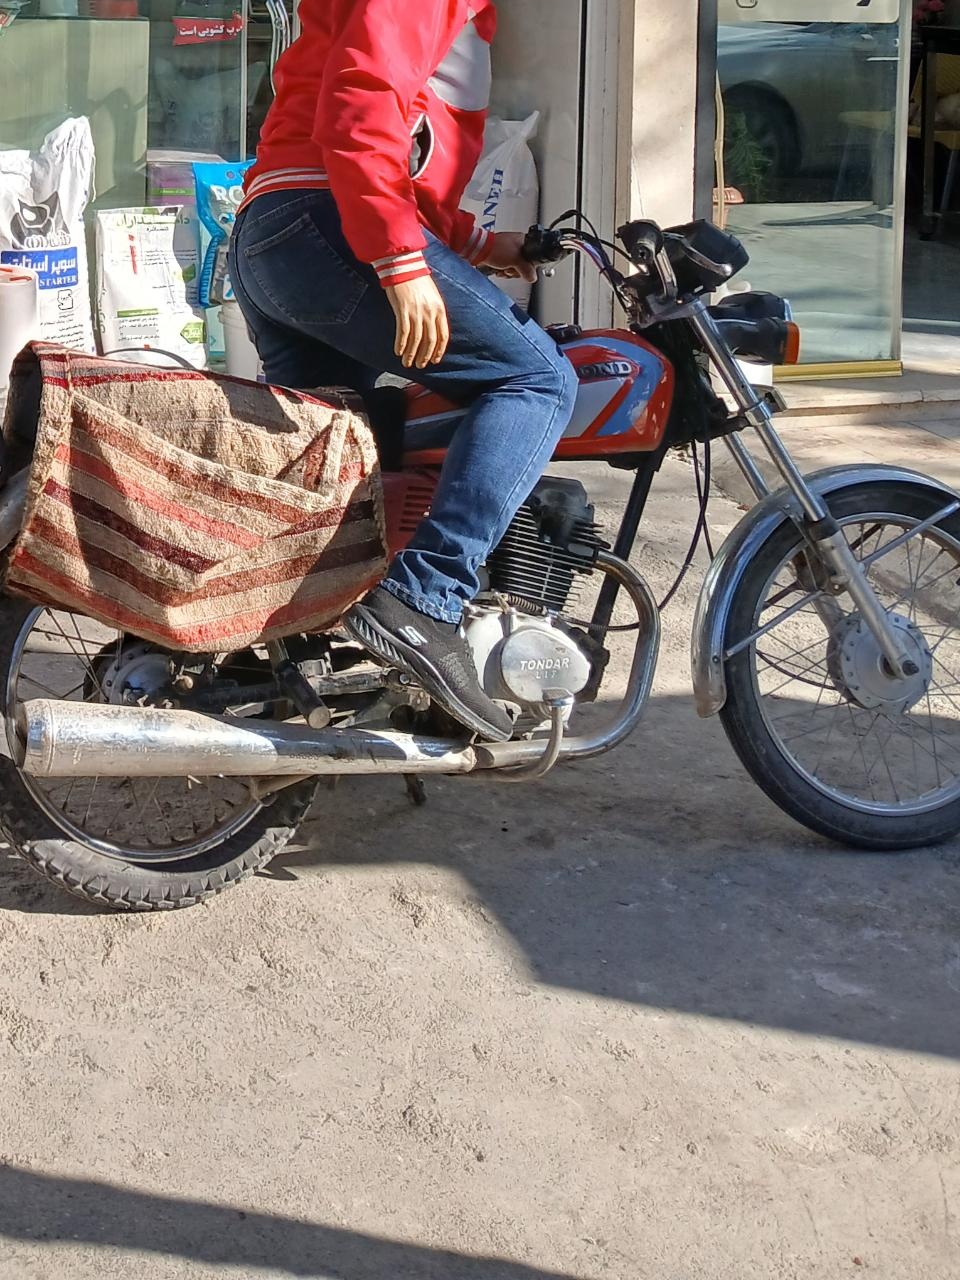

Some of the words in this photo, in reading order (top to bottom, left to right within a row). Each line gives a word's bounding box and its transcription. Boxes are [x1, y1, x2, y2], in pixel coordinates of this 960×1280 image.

[179, 24, 197, 37] است
[481, 168, 504, 231] ANEH
[51, 257, 76, 275] سوپر
[39, 274, 78, 287] STARTER
[520, 657, 570, 671] TONDAR
